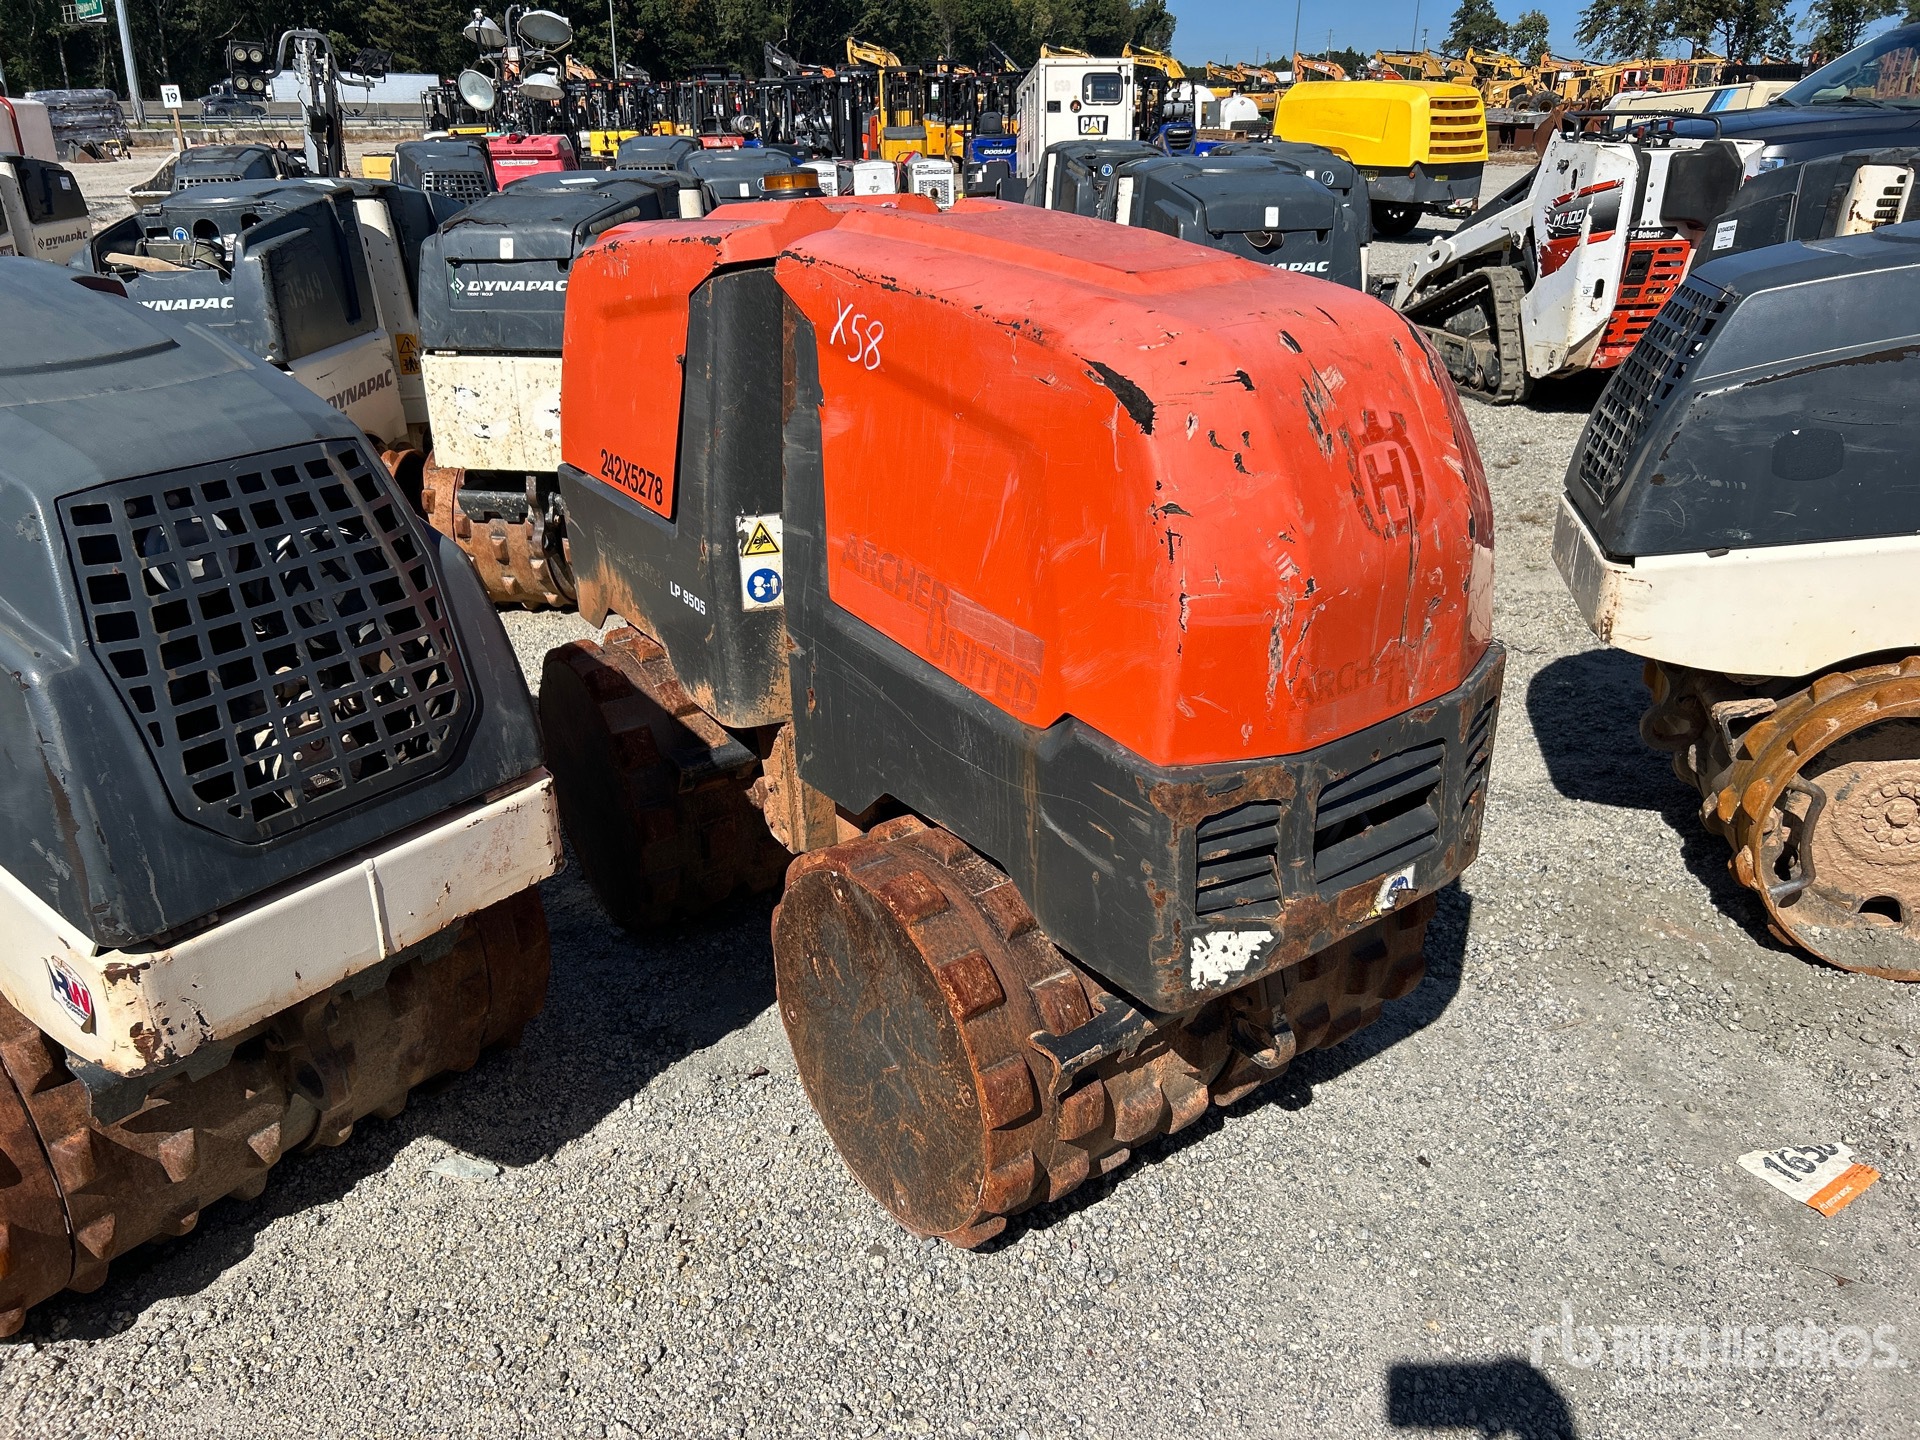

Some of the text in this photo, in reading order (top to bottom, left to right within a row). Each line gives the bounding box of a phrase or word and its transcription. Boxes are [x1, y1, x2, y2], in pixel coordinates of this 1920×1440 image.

[165, 92, 178, 103] 19
[1080, 117, 1106, 134] CAT
[45, 230, 88, 247] DYNAPAC
[1637, 230, 1661, 239] Bobcat
[467, 280, 569, 292] DYNAPAC
[829, 296, 884, 371] X58
[600, 448, 663, 506] 242X5278
[841, 533, 950, 628] ARCHER
[669, 580, 706, 616] LP 9505
[926, 600, 1039, 716] UNITED
